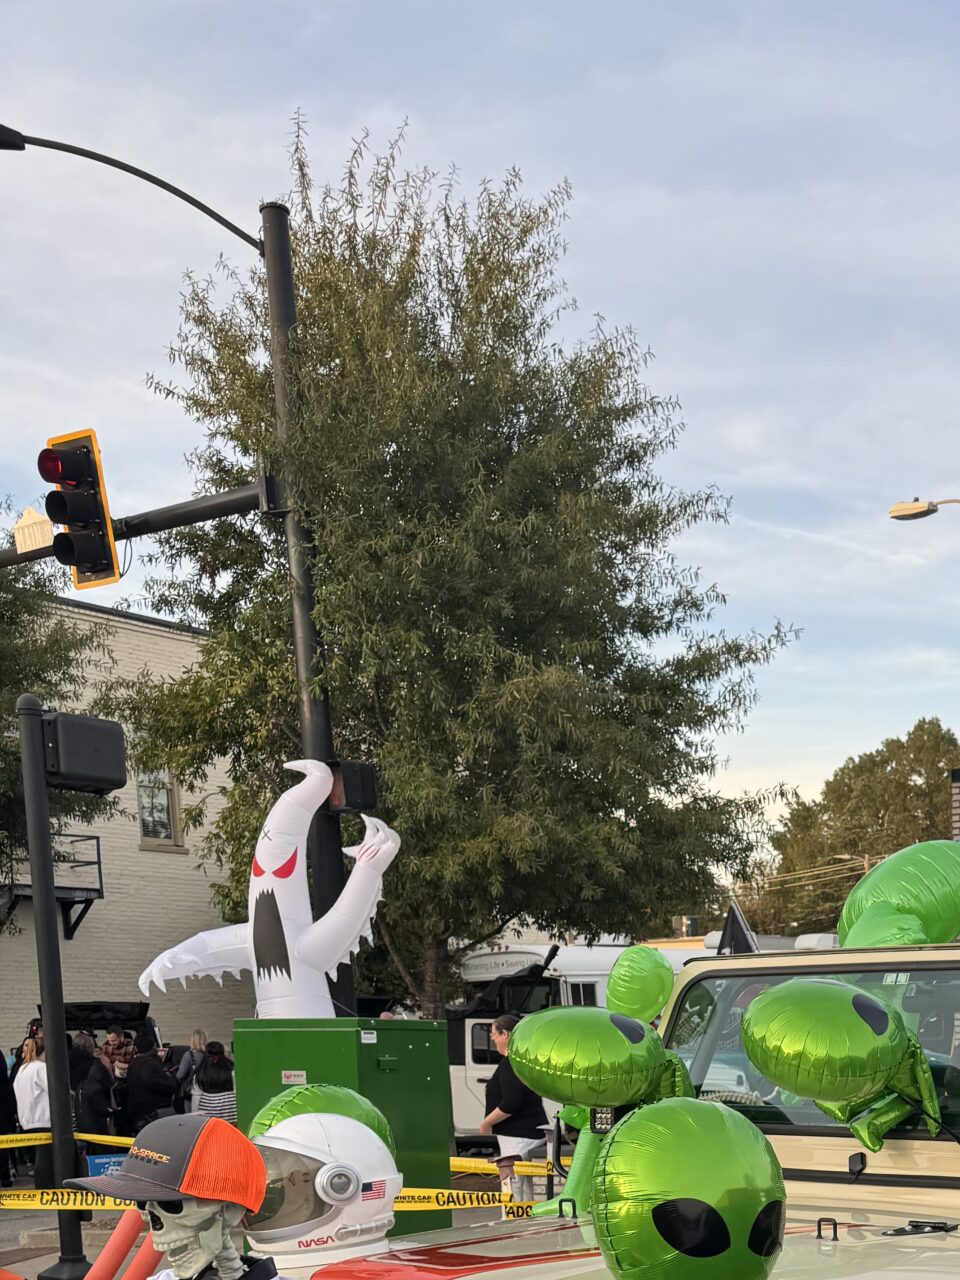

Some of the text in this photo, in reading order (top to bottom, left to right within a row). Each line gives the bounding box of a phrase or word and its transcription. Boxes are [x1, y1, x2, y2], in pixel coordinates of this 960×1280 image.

[40, 1190, 106, 1207] CAUTION
[435, 1191, 503, 1207] CAUTION
[297, 1235, 336, 1248] NASA
